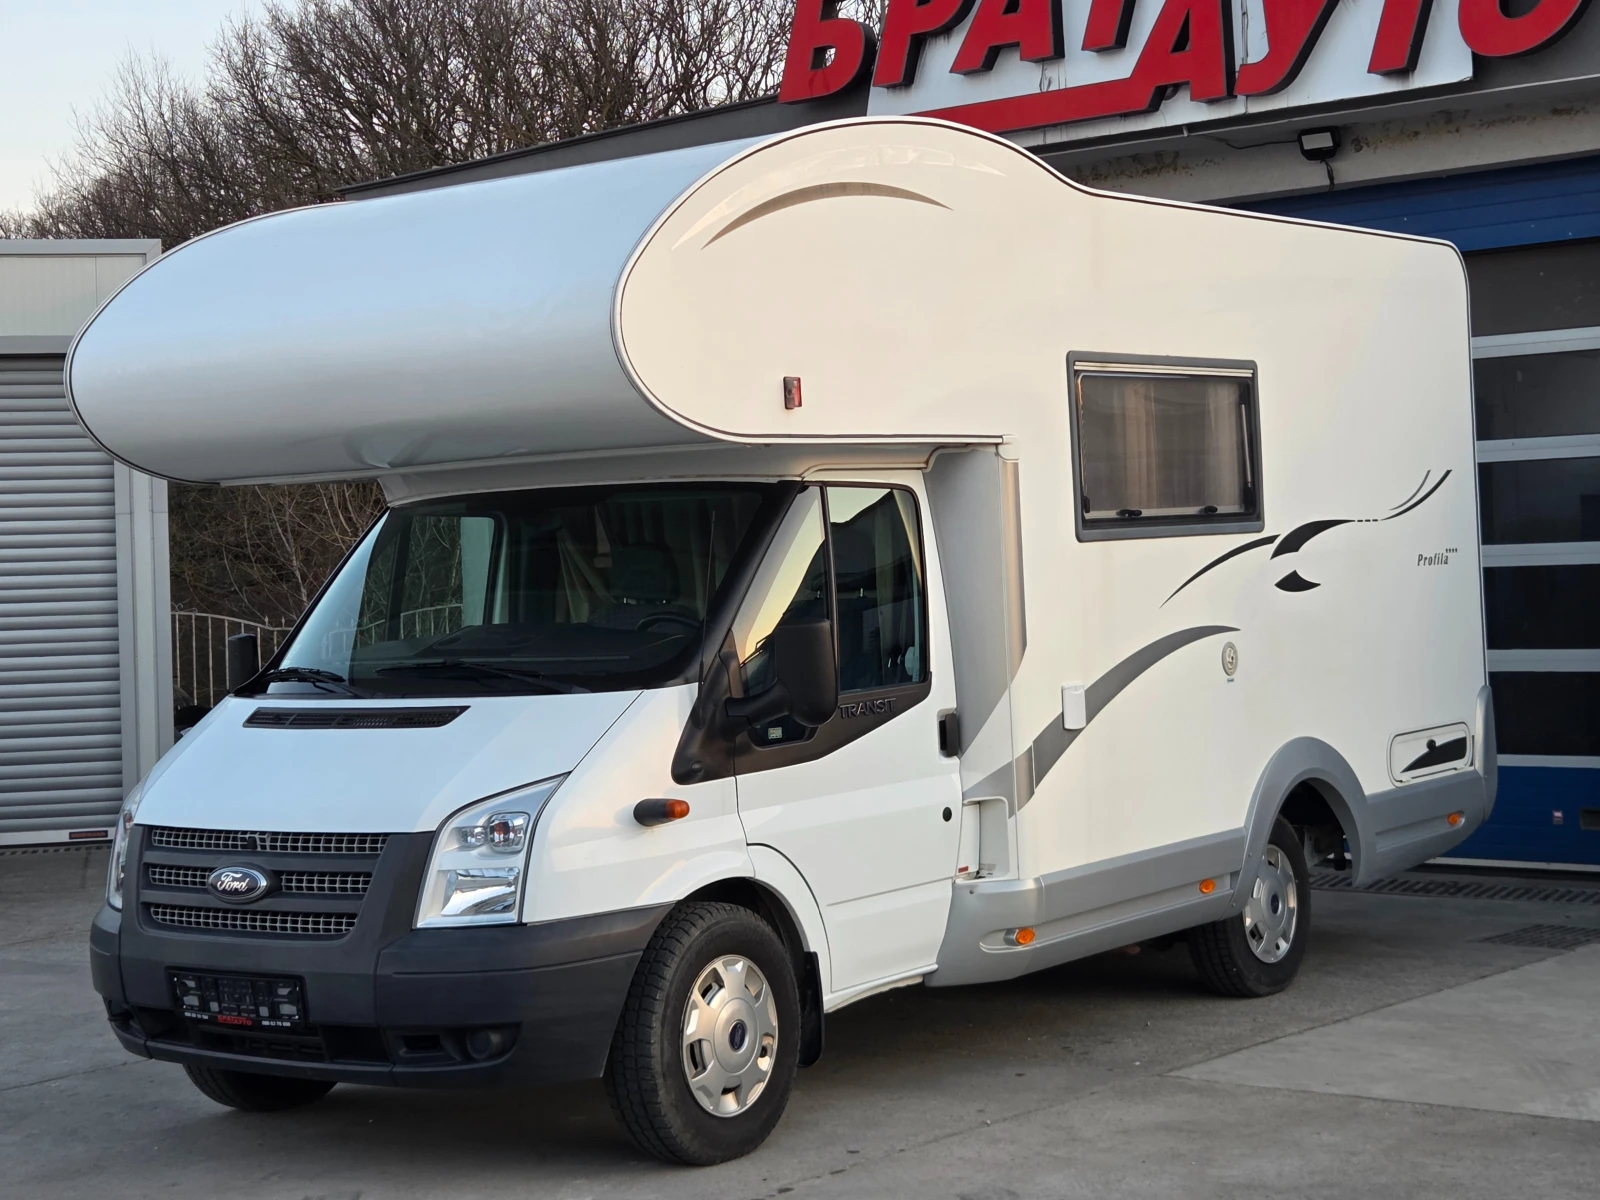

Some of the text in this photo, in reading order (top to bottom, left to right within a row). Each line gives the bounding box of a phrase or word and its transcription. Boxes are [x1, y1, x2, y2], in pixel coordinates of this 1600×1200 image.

[1417, 552, 1449, 567] Profila
[839, 698, 897, 719] TRANSIT
[217, 872, 250, 892] Ford
